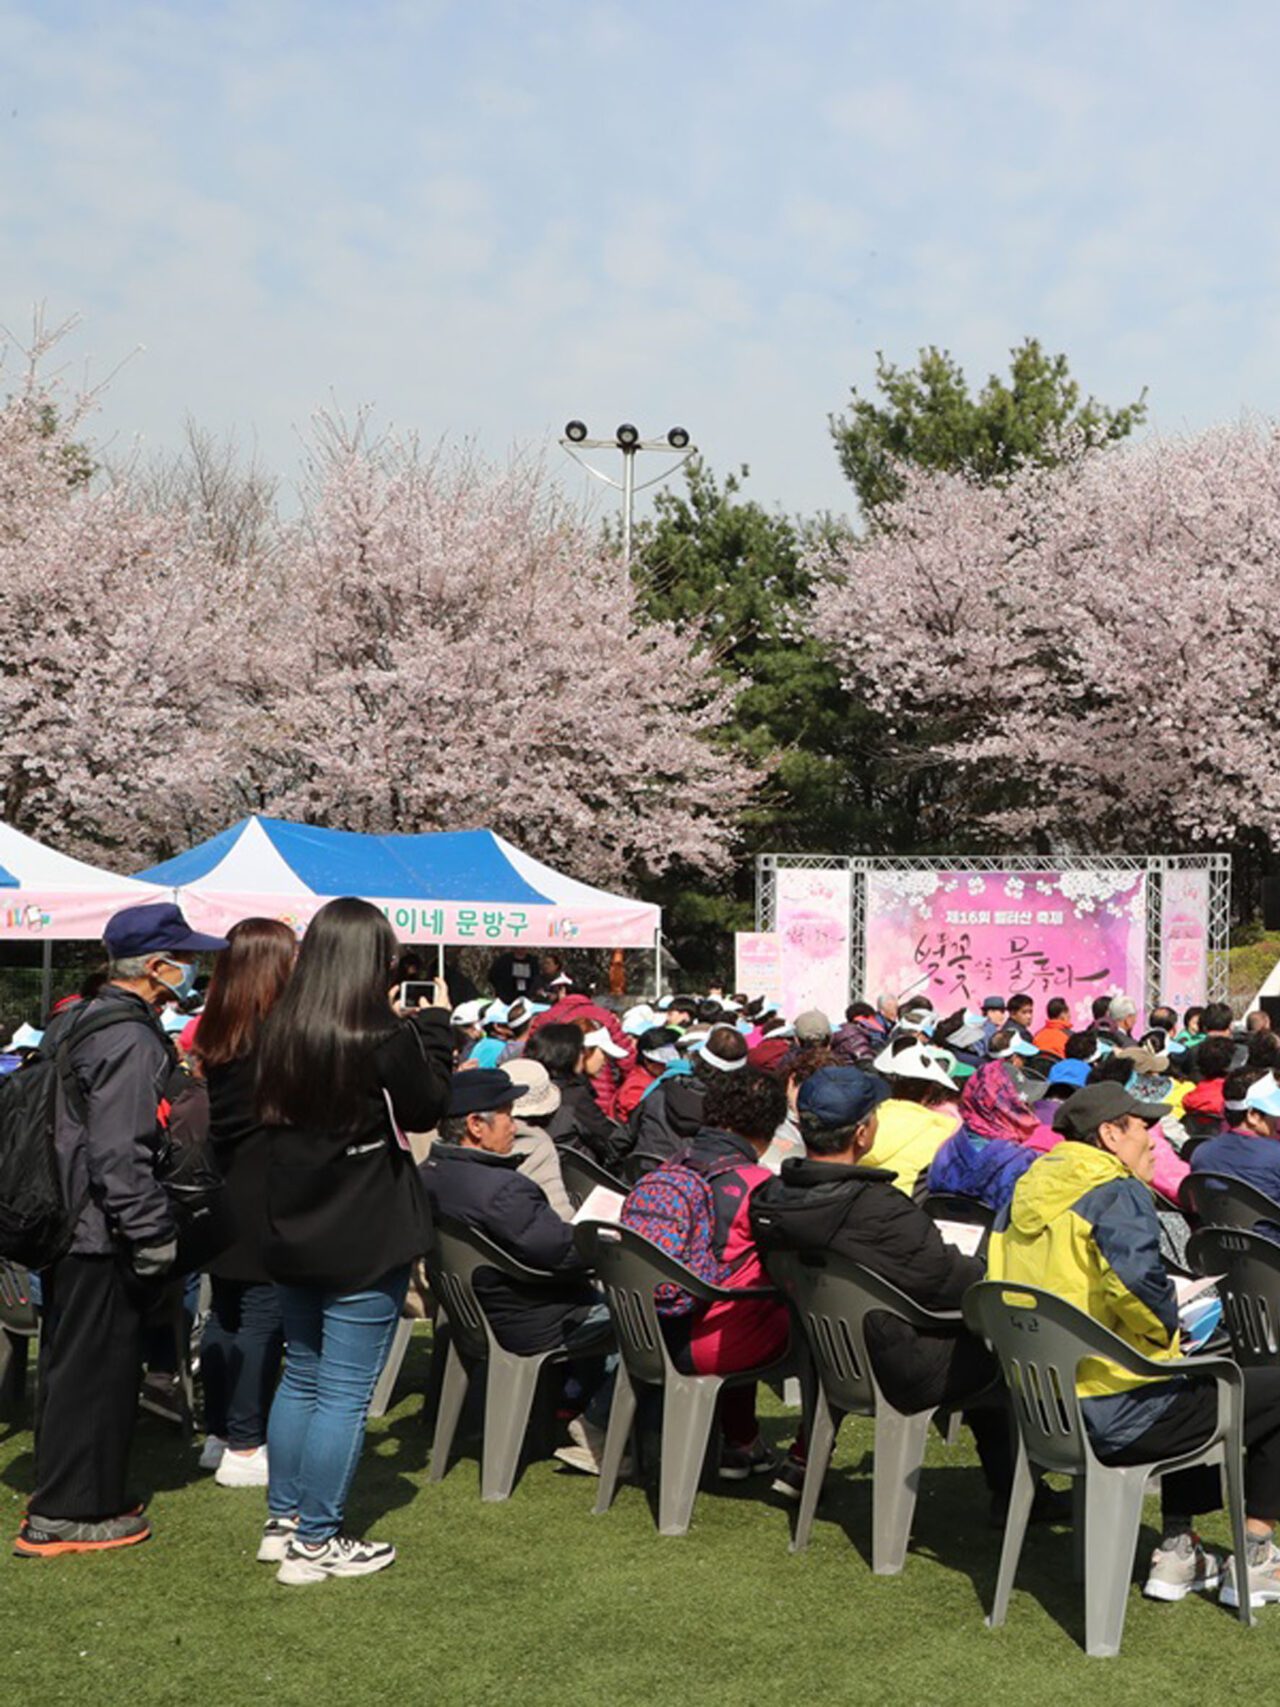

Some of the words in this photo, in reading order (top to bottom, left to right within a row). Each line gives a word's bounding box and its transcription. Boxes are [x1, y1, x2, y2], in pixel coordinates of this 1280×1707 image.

[384, 906, 444, 936] 이네
[456, 909, 529, 938] 문방구
[945, 910, 991, 925] 제16회
[1036, 910, 1064, 925] 축제
[1001, 936, 1110, 994] 물들다
